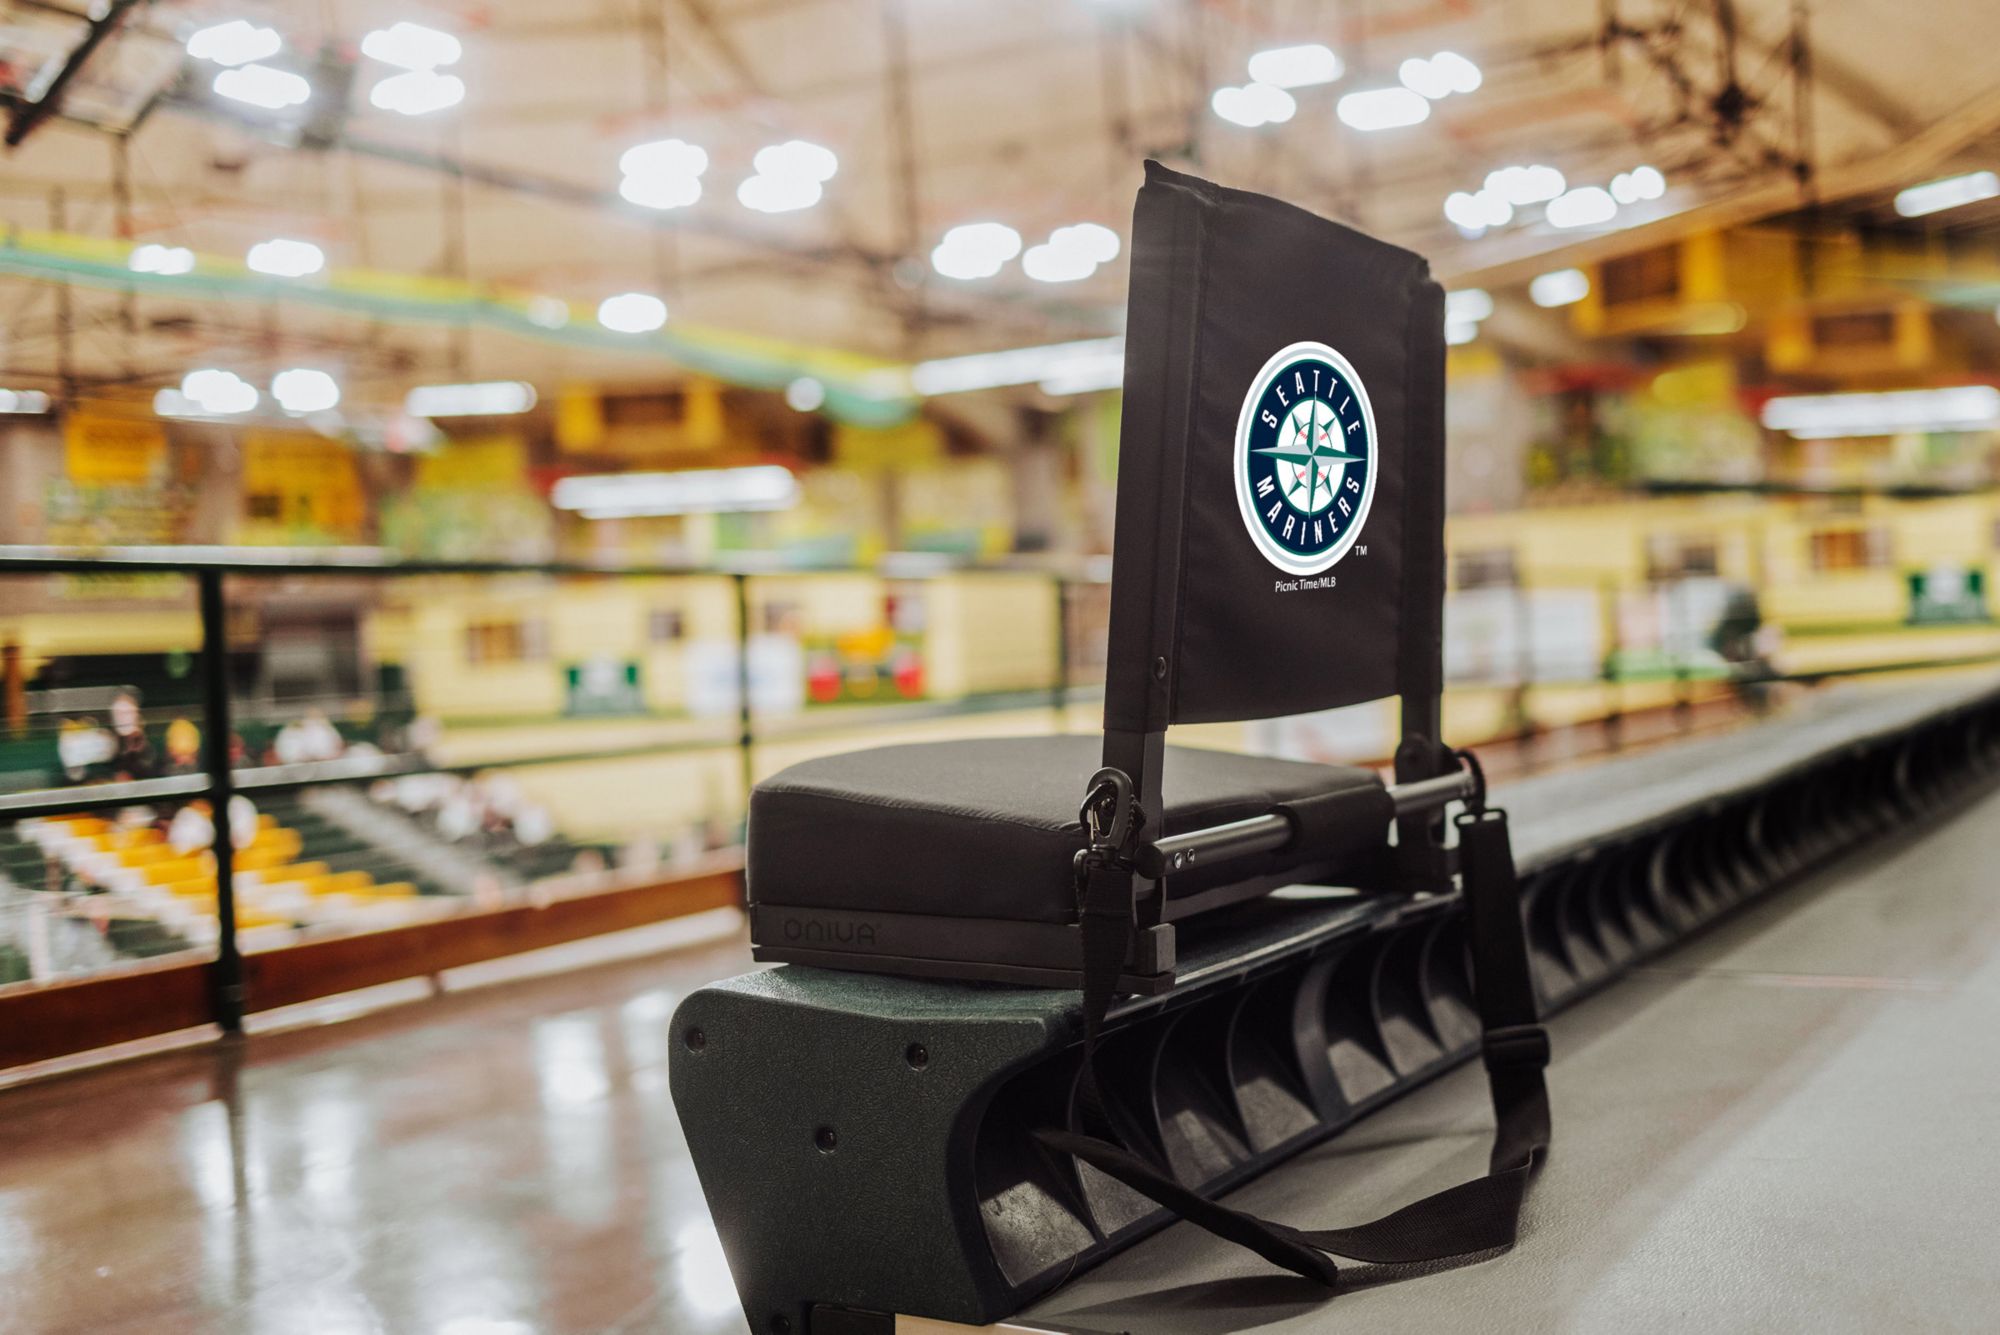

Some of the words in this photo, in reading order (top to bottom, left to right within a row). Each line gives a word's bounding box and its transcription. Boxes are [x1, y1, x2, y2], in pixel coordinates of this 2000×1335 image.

[1261, 369, 1361, 435] SEATTLE
[1256, 475, 1360, 545] MARINERS
[1355, 545, 1368, 556] TM
[1275, 579, 1298, 592] Picnic
[1299, 576, 1337, 590] Time/MLB
